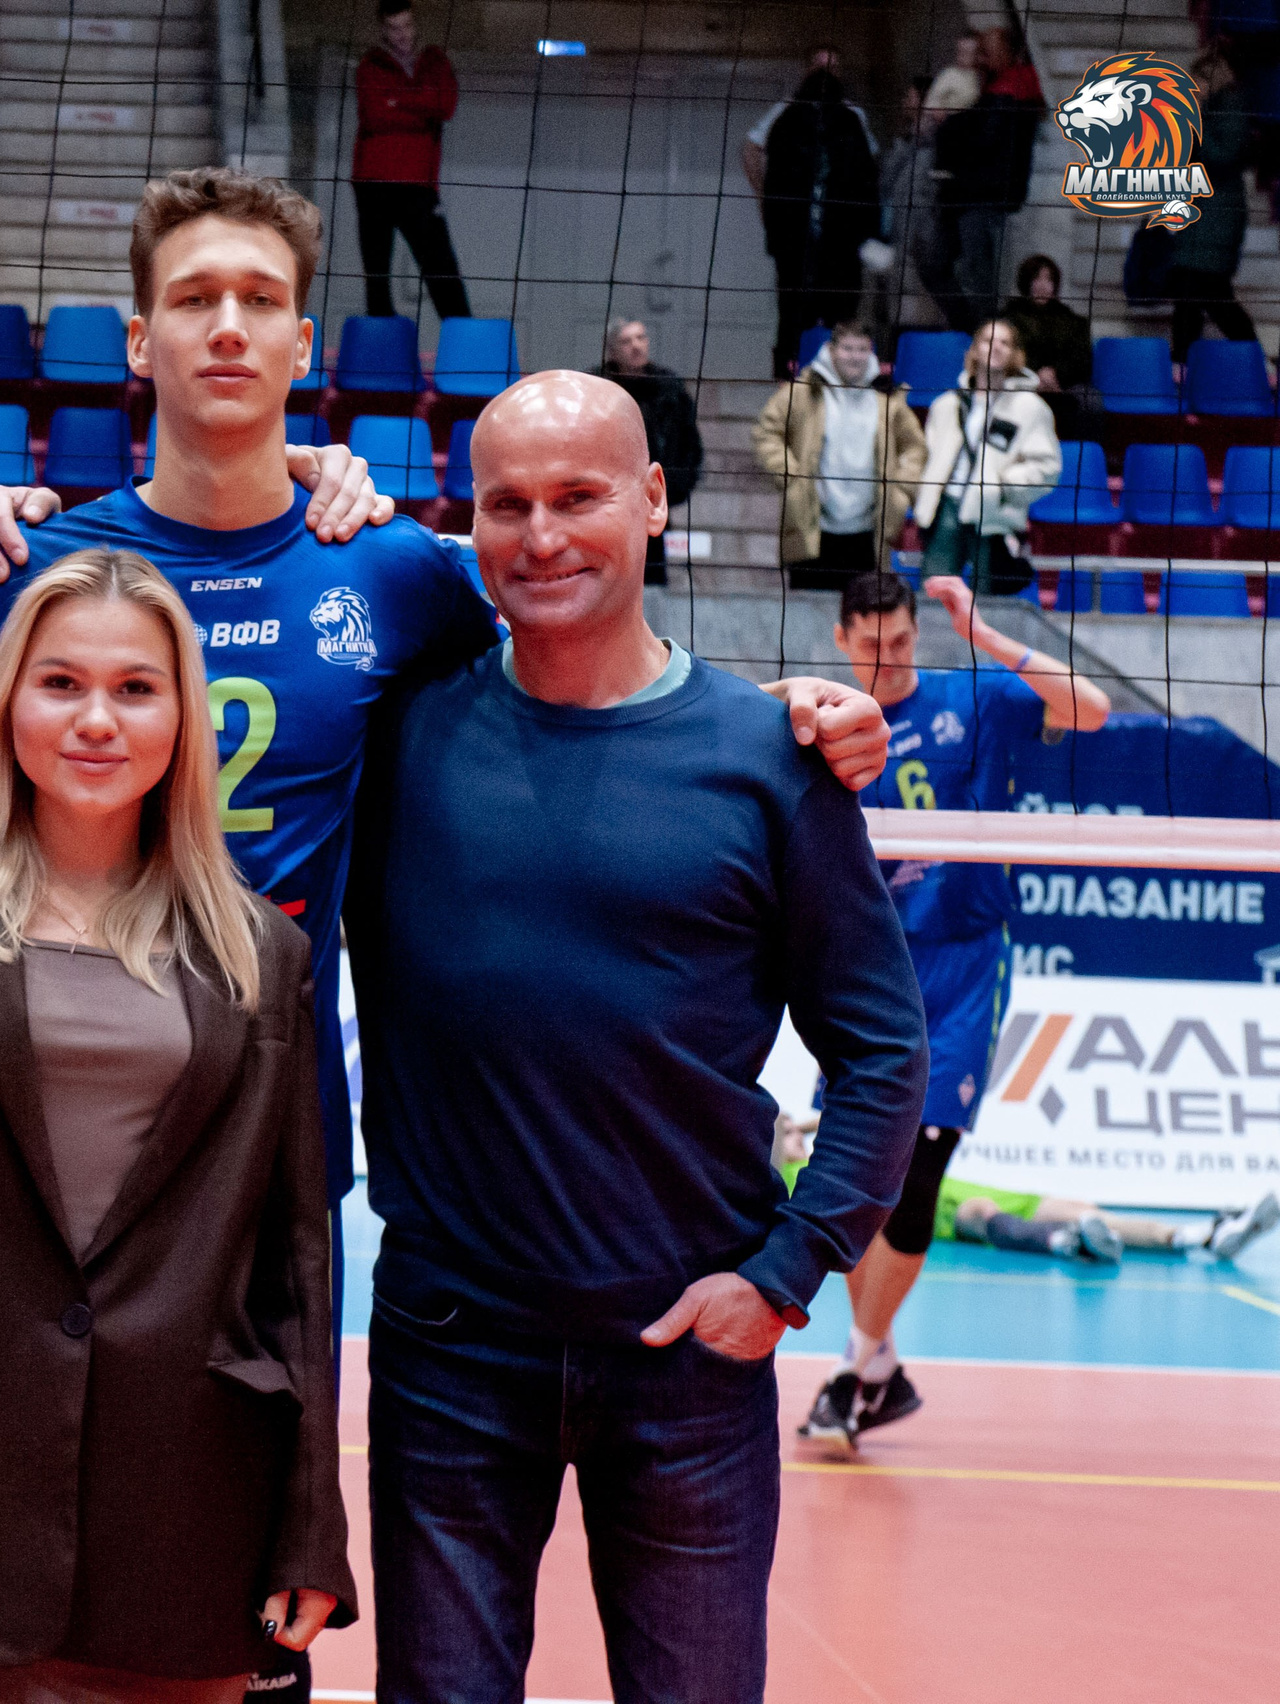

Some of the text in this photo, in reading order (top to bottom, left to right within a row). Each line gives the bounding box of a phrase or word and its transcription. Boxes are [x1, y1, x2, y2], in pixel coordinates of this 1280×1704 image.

[190, 577, 263, 592] ENSEN
[210, 619, 281, 647] ВФВ
[208, 676, 277, 833] 2
[895, 759, 937, 810] 6
[1068, 1147, 1166, 1170] МЕСТО
[1175, 1150, 1235, 1173] ДЛЯ
